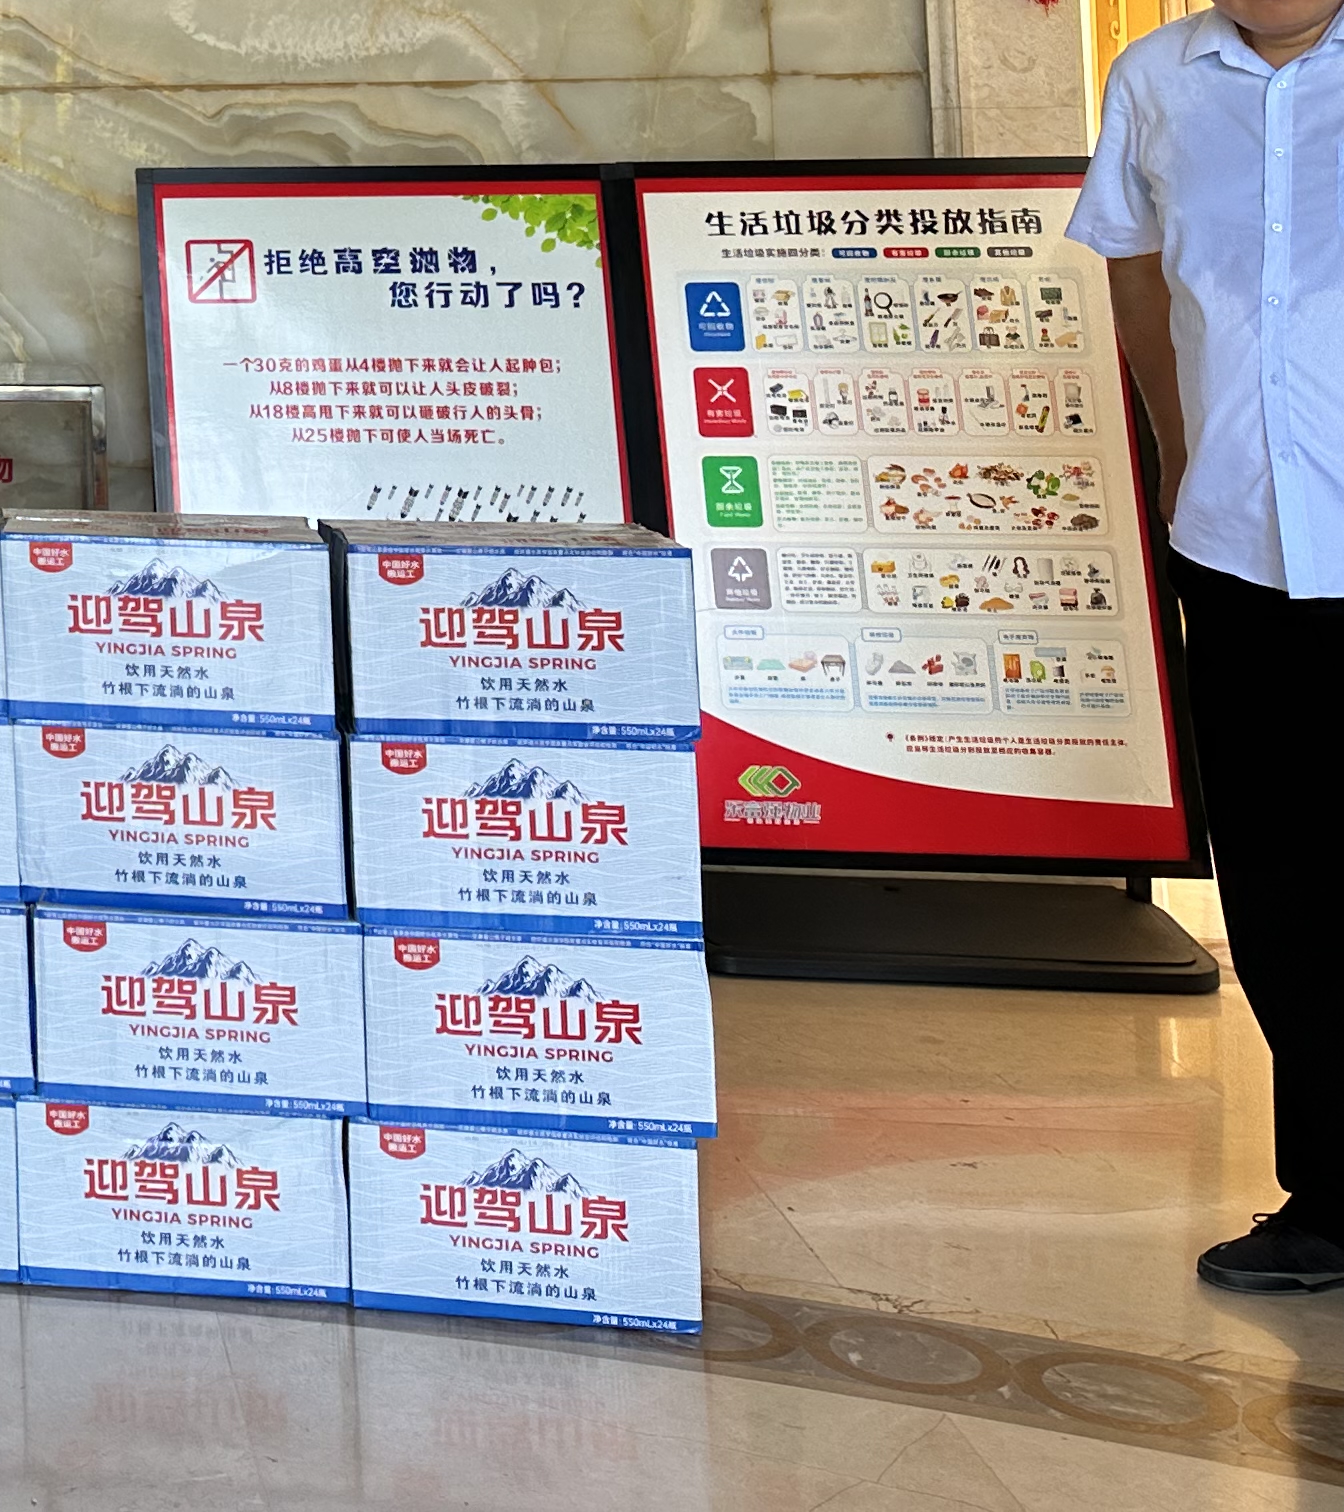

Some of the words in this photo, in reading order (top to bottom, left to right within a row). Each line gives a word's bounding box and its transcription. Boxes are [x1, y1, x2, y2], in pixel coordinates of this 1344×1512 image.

[705, 209, 1043, 236] 生活垃圾分类投放指南
[67, 594, 264, 642] 迎驾山泉
[419, 607, 624, 651] 迎驾山泉
[95, 642, 165, 655] YINGJIA
[172, 646, 237, 659] SPRING
[125, 663, 209, 680] 饮用天然水
[449, 655, 522, 668] YINGJIA
[529, 658, 596, 670] SPRING
[101, 681, 235, 700] 竹根下流淌的山泉
[481, 677, 568, 692] 饮用天然水
[456, 696, 595, 712] 竹根下流淌的山泉
[80, 781, 277, 830] 迎驾山泉
[422, 797, 628, 845] 迎驾山泉
[109, 829, 178, 843] YINGJIA
[184, 834, 249, 847] SPRING
[139, 850, 221, 868] 饮用天然水
[452, 846, 524, 860] YINGJIA
[531, 850, 599, 863] SPRING
[115, 868, 247, 889] 竹根下流淌的山泉
[483, 868, 570, 886] 饮用天然水
[458, 887, 597, 906] 竹根下流淌的山泉
[101, 974, 299, 1026] 迎驾山泉
[435, 993, 642, 1045] 迎驾山泉
[129, 1024, 199, 1039] YINGJIA
[205, 1029, 271, 1043] SPRING
[159, 1046, 242, 1064] 饮用天然水
[465, 1043, 538, 1058] YINGJIA
[545, 1048, 613, 1063] SPRING
[134, 1064, 268, 1085] 竹根下流淌的山泉
[496, 1066, 584, 1085] 饮用天然水
[471, 1085, 612, 1106] 竹根下流淌的山泉
[83, 1158, 280, 1211] 迎驾山泉
[112, 1208, 181, 1223] YINGJIA
[188, 1213, 253, 1228] SPRING
[419, 1183, 629, 1242] 迎驾山泉
[141, 1230, 225, 1250] 饮用天然水
[449, 1234, 523, 1252] YINGJIA
[530, 1242, 599, 1259] SPRING
[117, 1248, 250, 1271] 竹根下流淌的山泉
[481, 1258, 569, 1279] 饮用天然水
[456, 1275, 596, 1301] 竹根下流淌的山泉
